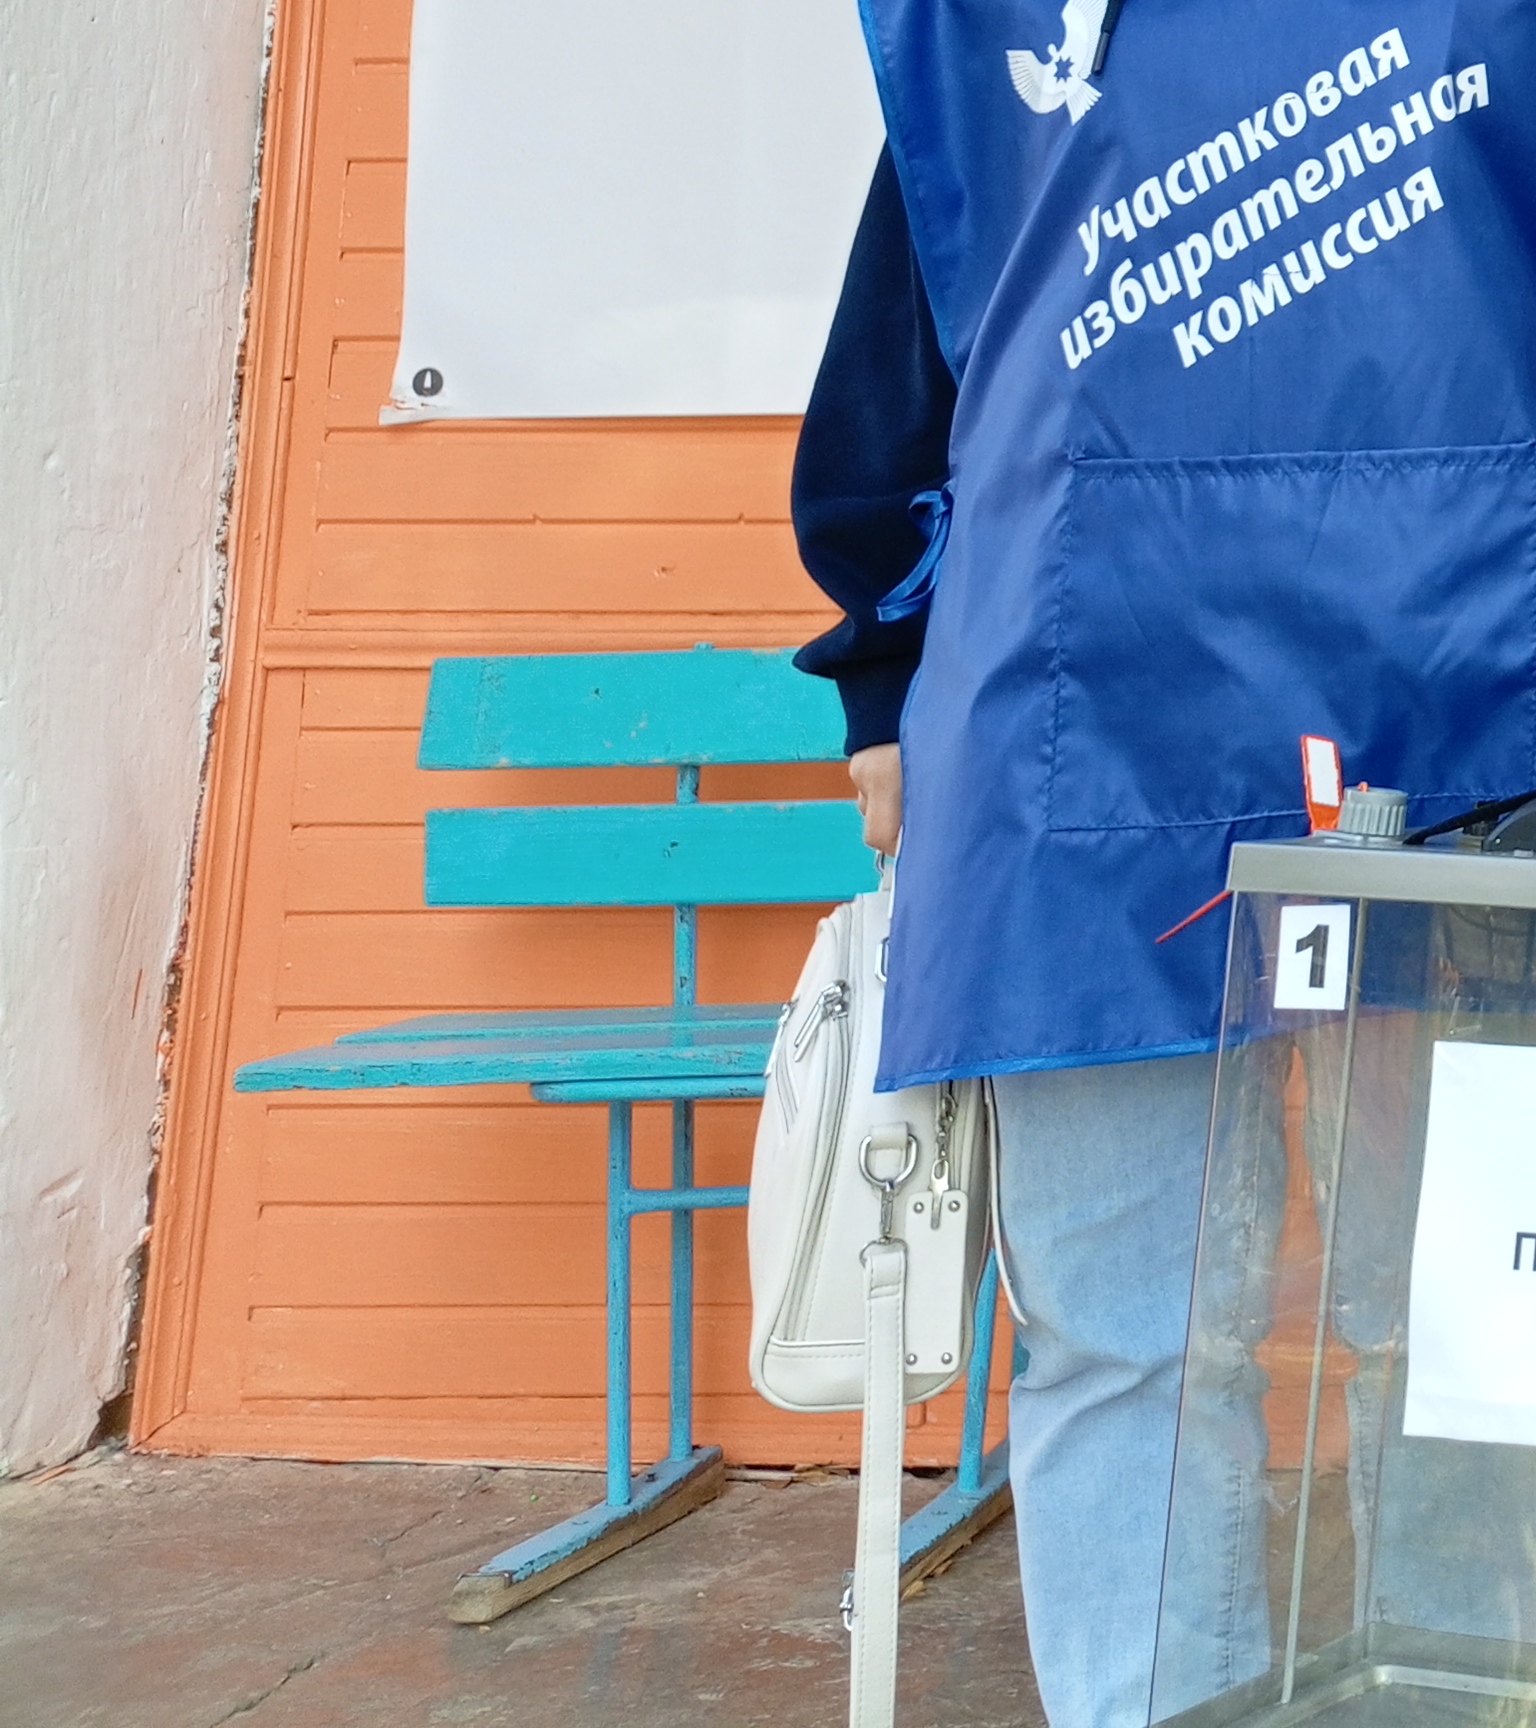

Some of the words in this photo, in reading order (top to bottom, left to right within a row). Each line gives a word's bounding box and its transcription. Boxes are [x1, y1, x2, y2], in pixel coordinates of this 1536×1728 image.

[1059, 62, 1490, 370] избирательная
[1171, 165, 1445, 369] комиссия
[1295, 924, 1331, 989] 1
